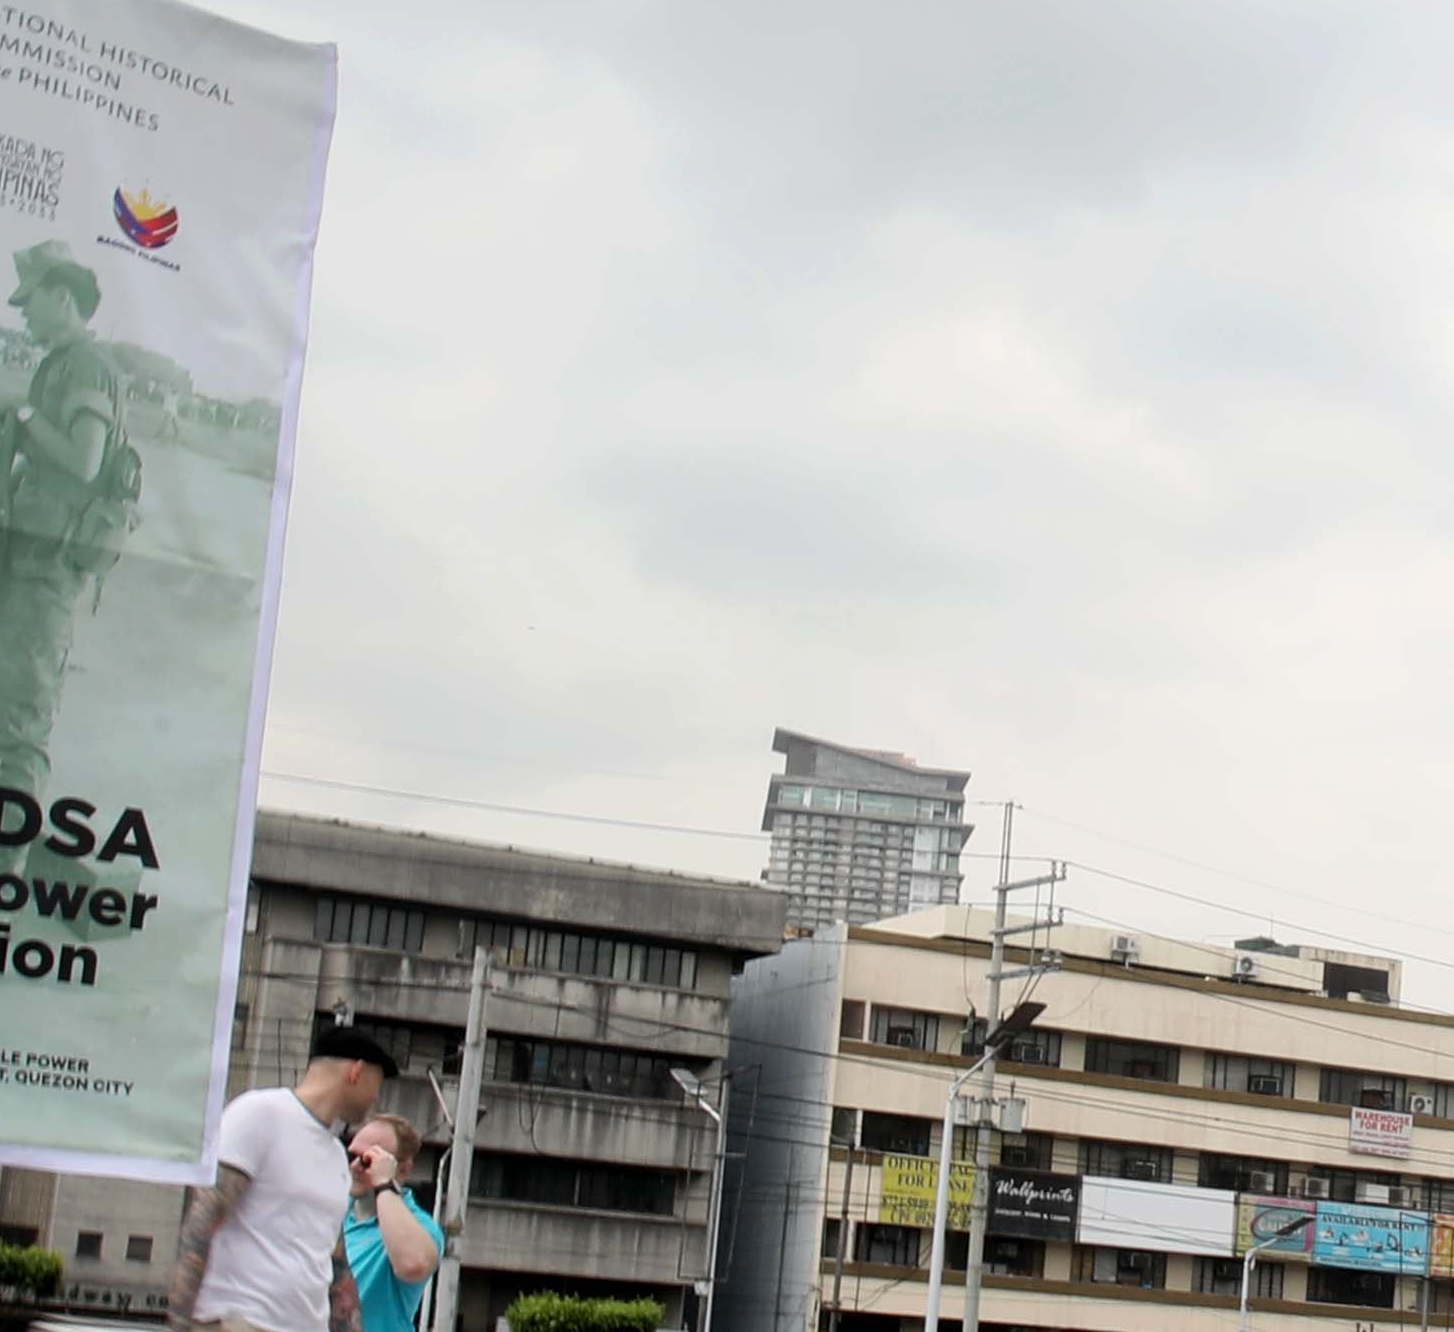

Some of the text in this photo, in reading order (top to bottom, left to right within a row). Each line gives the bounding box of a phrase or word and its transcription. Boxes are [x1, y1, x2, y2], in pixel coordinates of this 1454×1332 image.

[99, 40, 236, 106] HISTORICAL
[17, 67, 160, 132] PHILIPPINES
[25, 1052, 90, 1074] POWER
[15, 1069, 88, 1092] QUEZON
[93, 1078, 134, 1096] CITY
[1355, 1110, 1410, 1126] WAREHOUSE
[897, 1174, 924, 1187] FOR
[995, 1177, 1074, 1205] Wallprints
